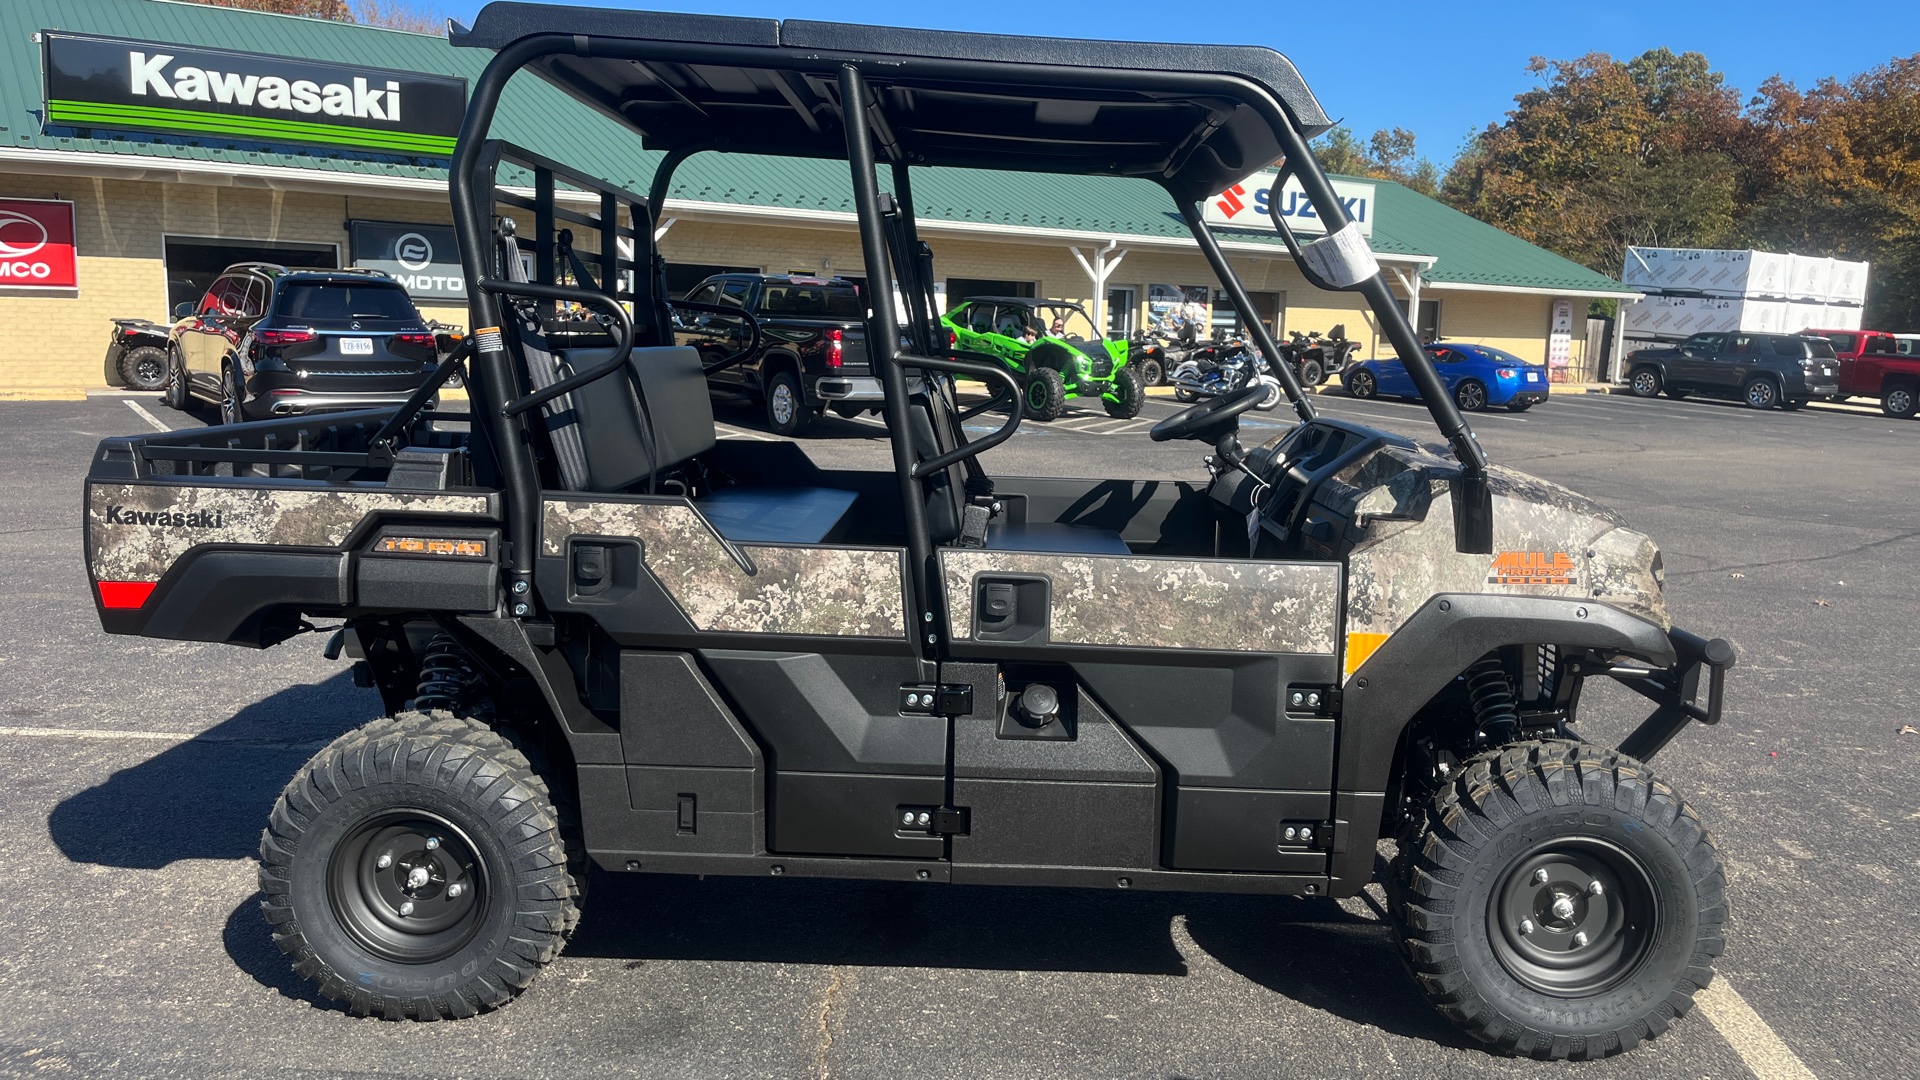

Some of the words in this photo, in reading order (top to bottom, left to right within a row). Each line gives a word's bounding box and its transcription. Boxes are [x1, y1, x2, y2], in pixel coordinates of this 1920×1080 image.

[130, 51, 400, 122] Kawasaki
[1254, 188, 1366, 223] SUZKI
[106, 505, 222, 528] Kawasaki
[1491, 551, 1576, 569] MULE
[1536, 569, 1567, 577] FXT
[1496, 811, 1613, 858] DURO
